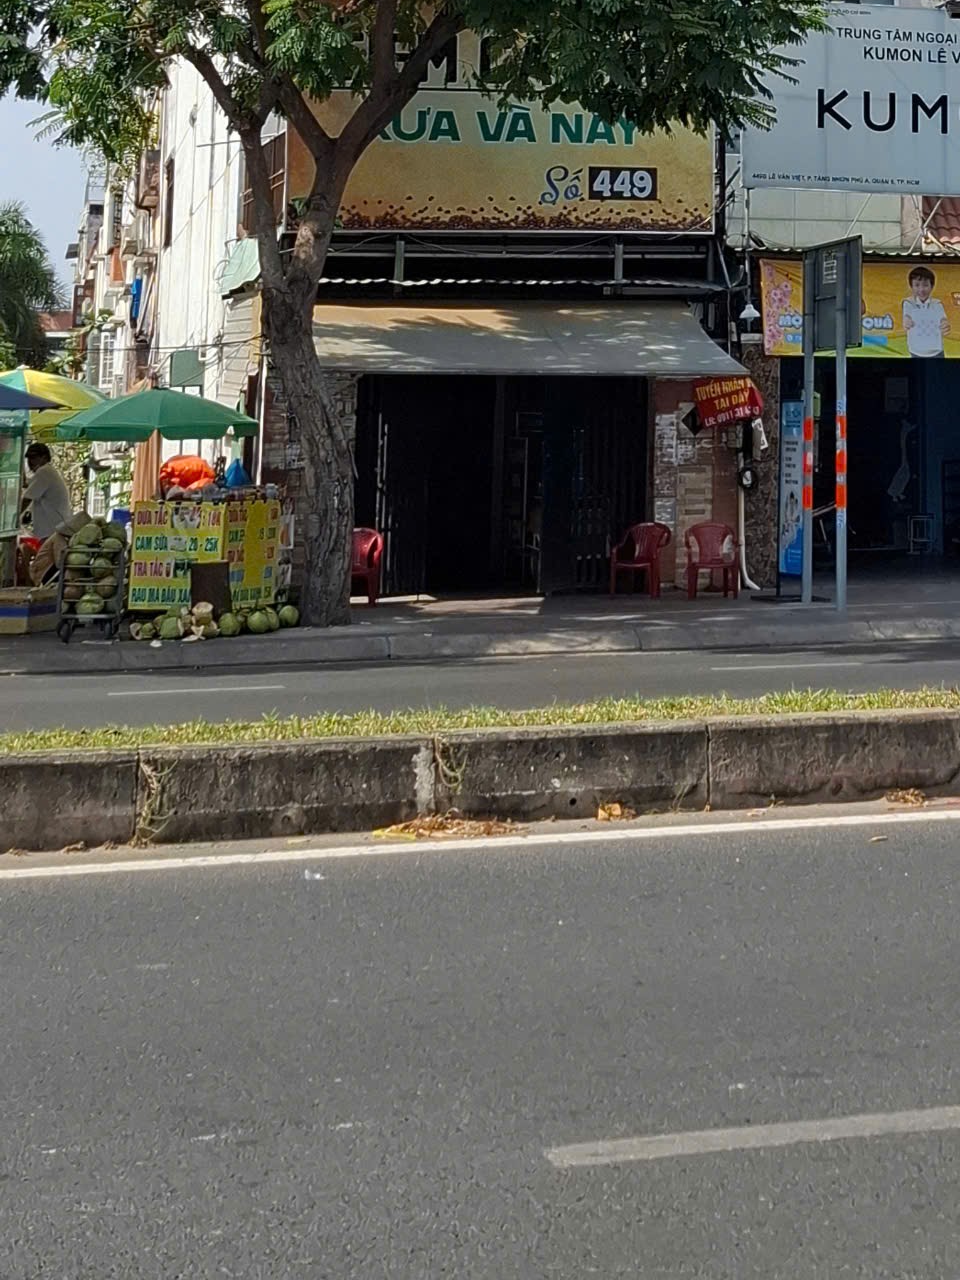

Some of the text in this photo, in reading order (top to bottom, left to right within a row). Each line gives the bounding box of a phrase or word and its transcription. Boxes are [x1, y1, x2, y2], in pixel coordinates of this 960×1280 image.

[836, 27, 881, 40] TRUNG
[886, 28, 913, 42] TÂM
[916, 32, 957, 46] NGOẠI
[863, 46, 922, 63] KUMON
[928, 48, 947, 64] LÊ
[476, 104, 537, 143] VÀ
[540, 166, 653, 205] Số 449
[135, 536, 152, 551] CAM
